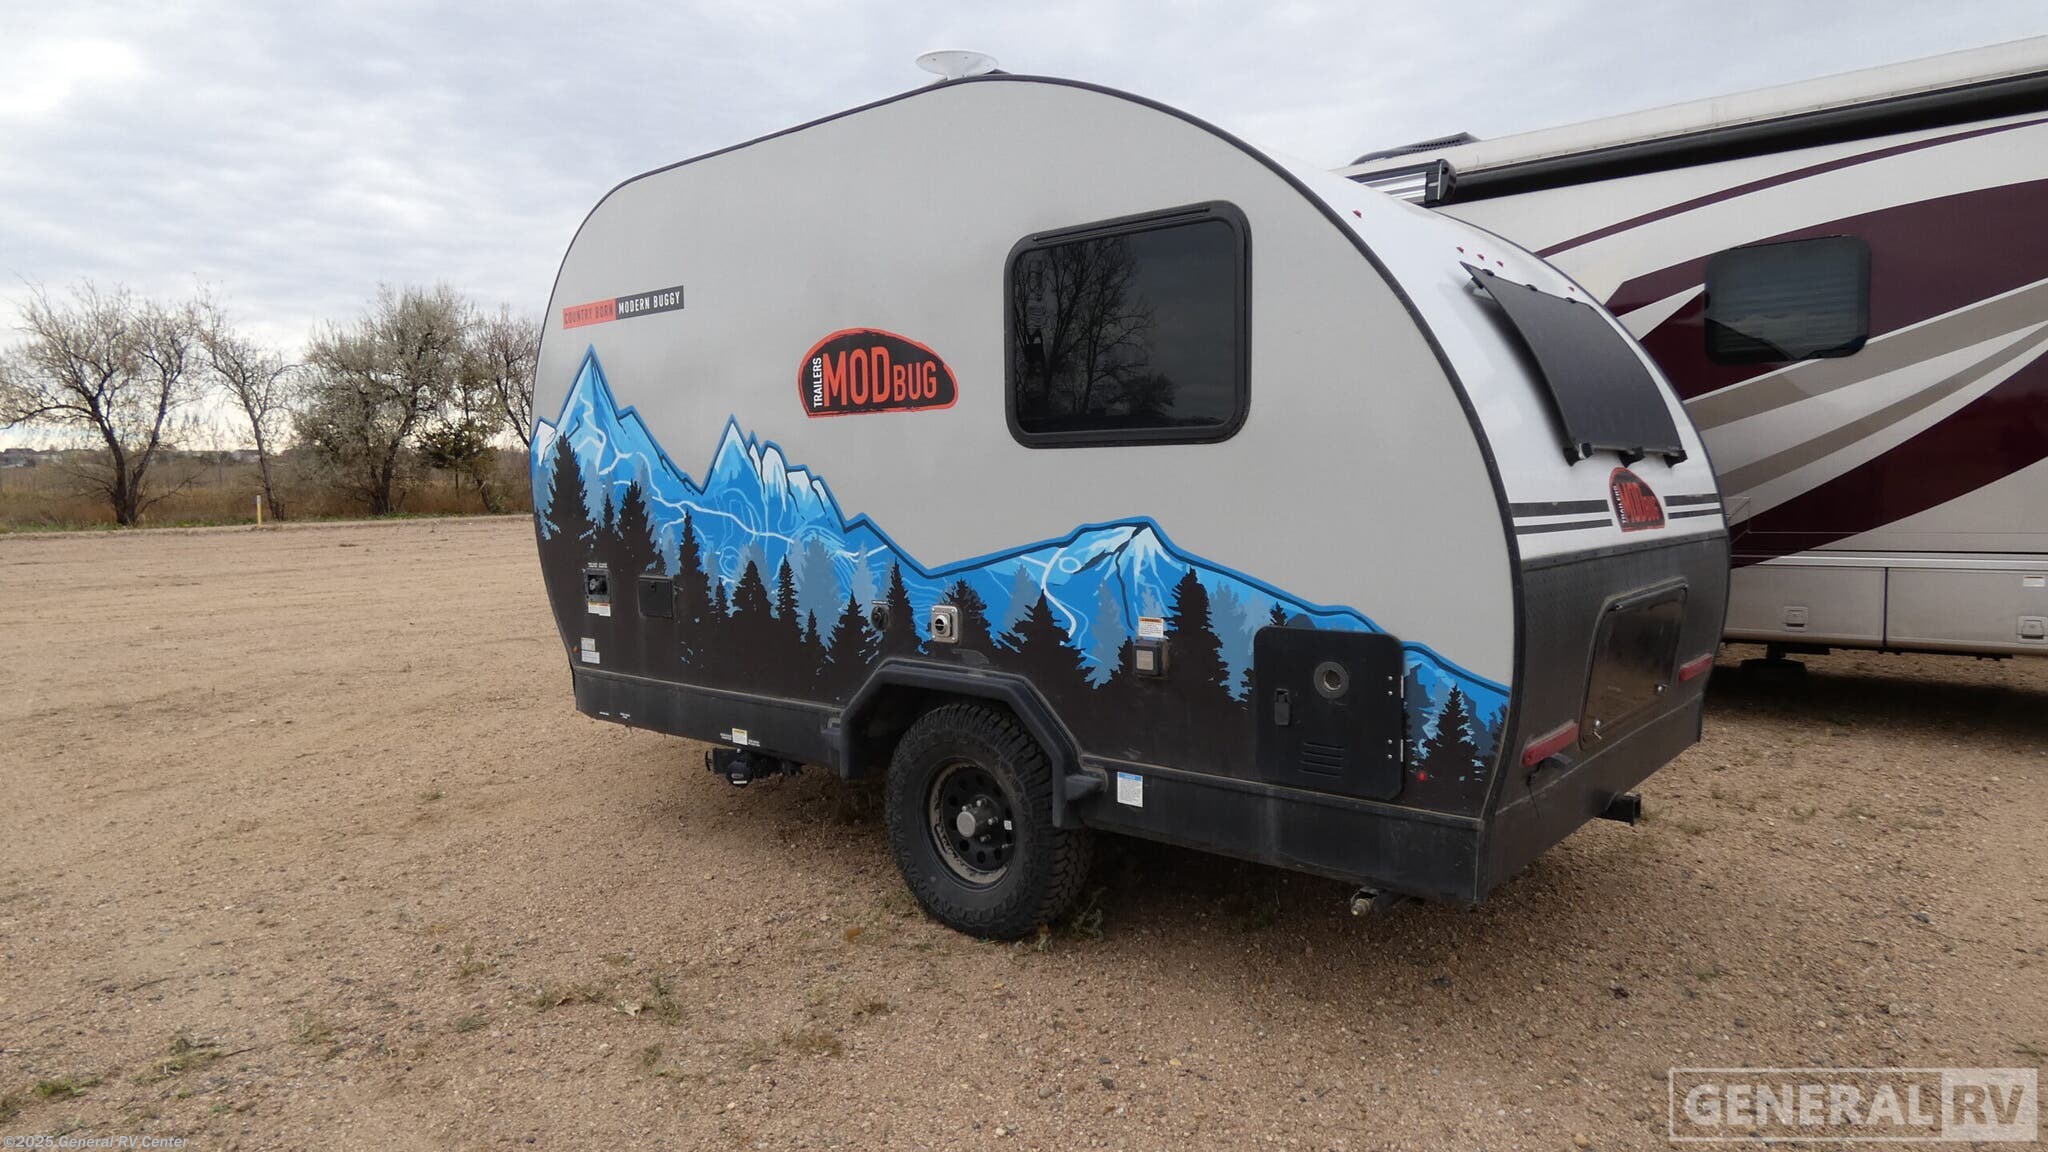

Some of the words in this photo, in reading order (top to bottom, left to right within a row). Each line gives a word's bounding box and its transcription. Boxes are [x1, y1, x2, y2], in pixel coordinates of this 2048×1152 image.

[564, 308, 592, 325] COUNTRY
[595, 303, 614, 319] BORN
[618, 299, 650, 315] MODERN
[653, 291, 680, 309] BUGGY
[811, 356, 823, 408] TRAILERS
